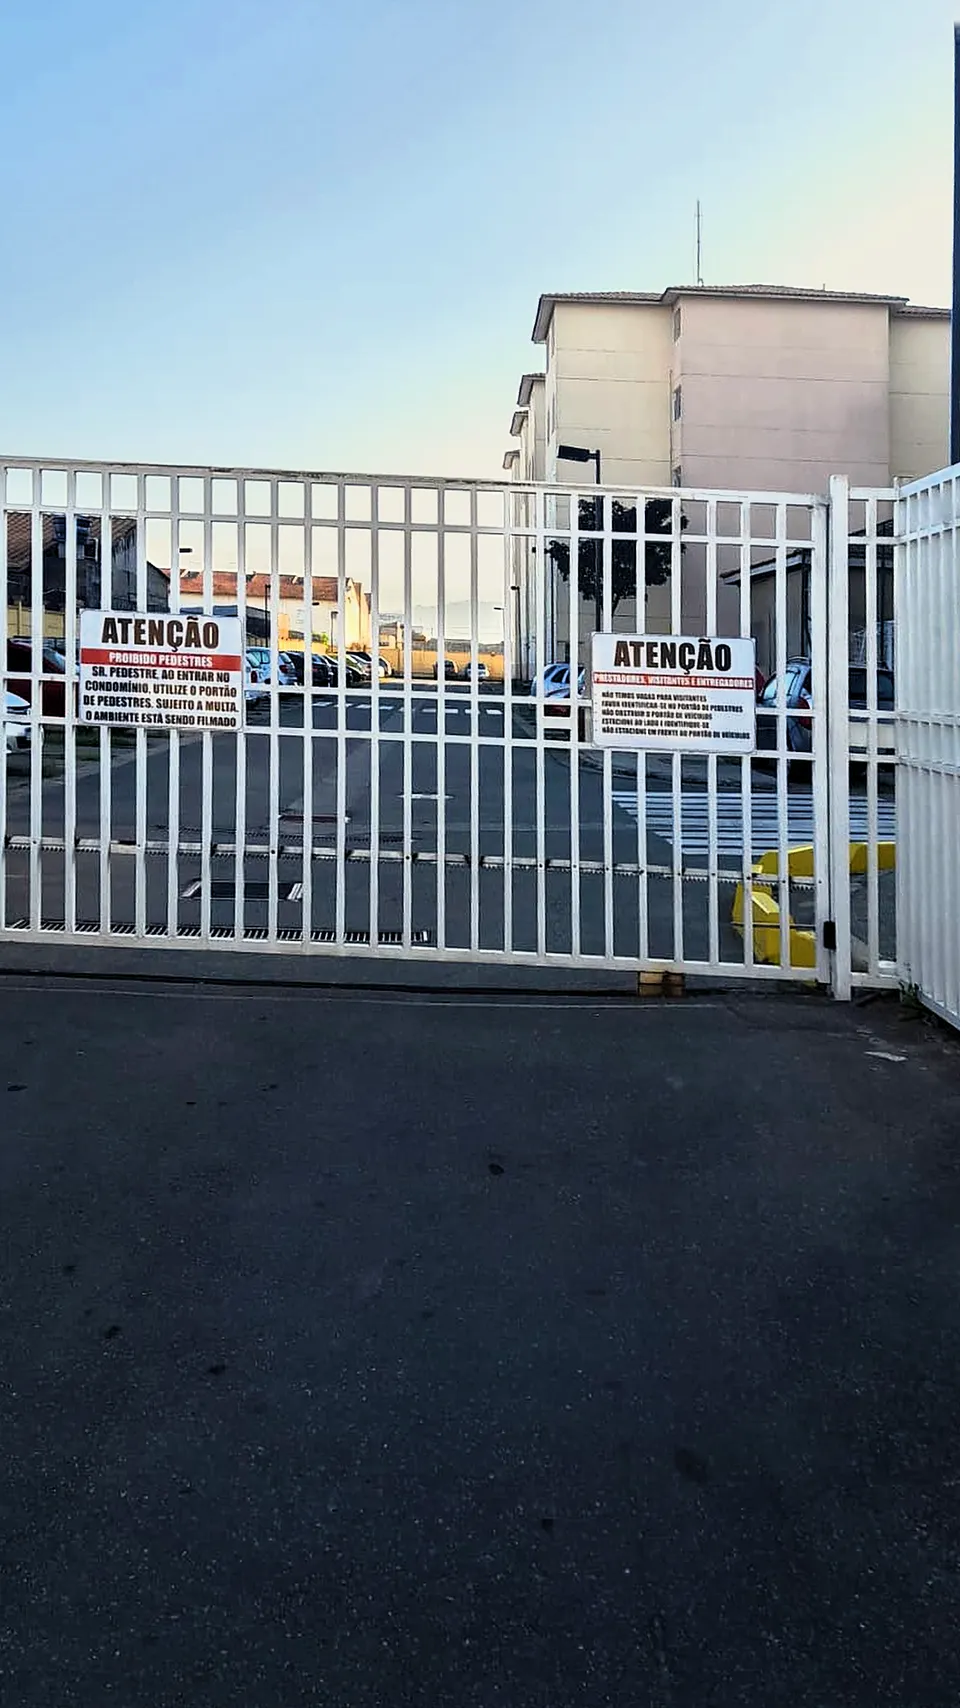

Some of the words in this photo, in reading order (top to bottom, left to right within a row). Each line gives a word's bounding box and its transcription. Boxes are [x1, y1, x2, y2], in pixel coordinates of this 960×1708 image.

[102, 616, 219, 652] ATENÇÃO
[109, 652, 157, 664] PROIBIDO
[159, 655, 212, 667] PEDESTRES
[614, 638, 731, 674] ATENÇÃO
[92, 666, 107, 677] SR.
[162, 670, 174, 680] AO
[177, 670, 214, 682] ENTRAR
[216, 672, 230, 682] NO
[648, 676, 689, 685] VISITANTES
[691, 677, 695, 685] E
[697, 677, 753, 688] ENTREGADORES
[153, 685, 188, 695] UTILIZE
[190, 686, 196, 695] O
[200, 685, 236, 697] PORTÃO
[84, 695, 95, 706] DE
[156, 699, 194, 710] SUJEITO
[196, 701, 203, 710] A
[206, 701, 238, 712] MULTA.
[86, 711, 92, 720] O
[94, 711, 139, 723] AMBIENTE
[165, 715, 195, 725] SENDO
[197, 716, 236, 727] FILMADO
[685, 711, 712, 720] VEÍCULOS
